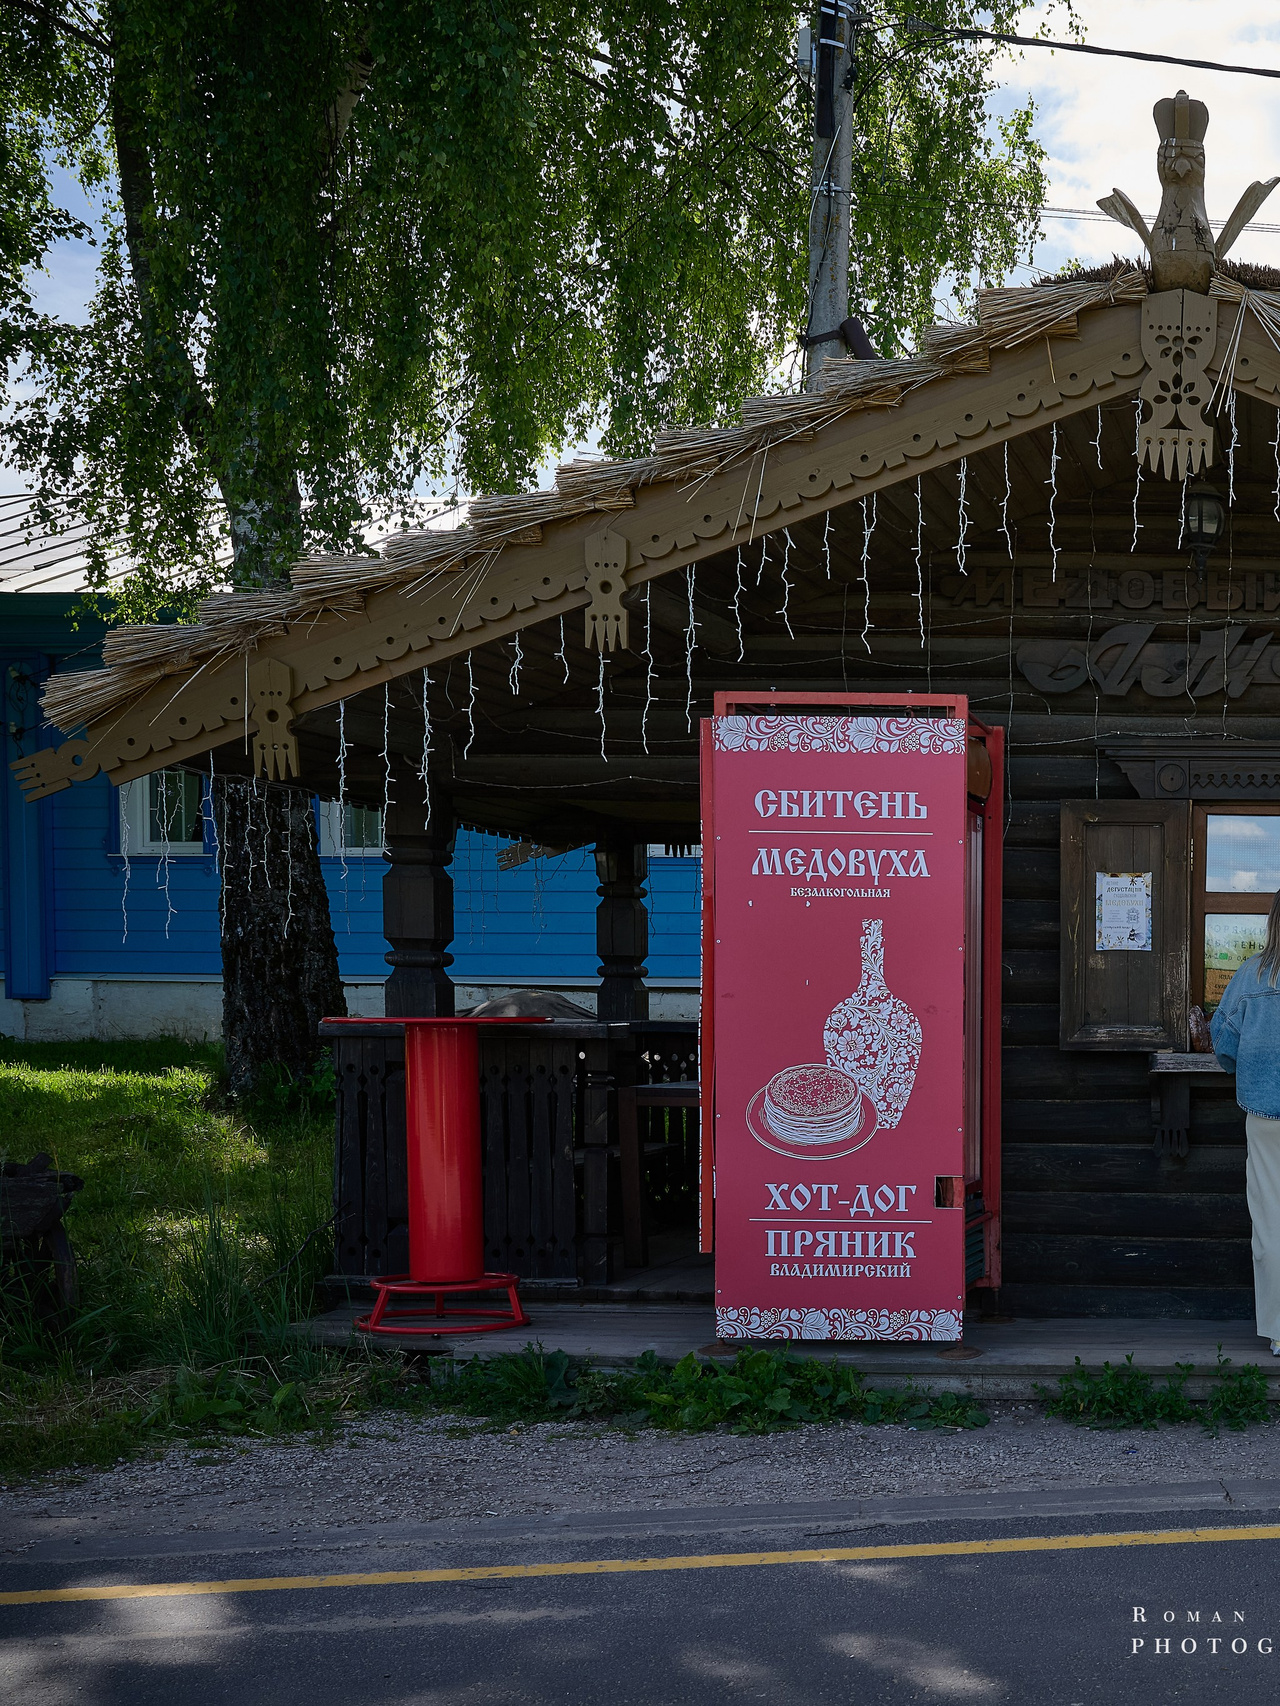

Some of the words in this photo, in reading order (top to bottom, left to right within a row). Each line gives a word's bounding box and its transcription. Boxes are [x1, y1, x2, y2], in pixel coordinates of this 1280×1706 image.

[754, 789, 928, 819] СБИТЕНЬ
[751, 848, 931, 885] МЕДОВУХА
[790, 887, 891, 898] БЕЗАЛКОГОЛЬНАЯ
[1206, 939, 1265, 950] СБИТЕНЬ
[764, 1183, 917, 1217] ХОТ-ДОГ
[764, 1230, 917, 1258] ПРЯНИК
[770, 1263, 911, 1279] ВЛАДИМИРСКИЙ
